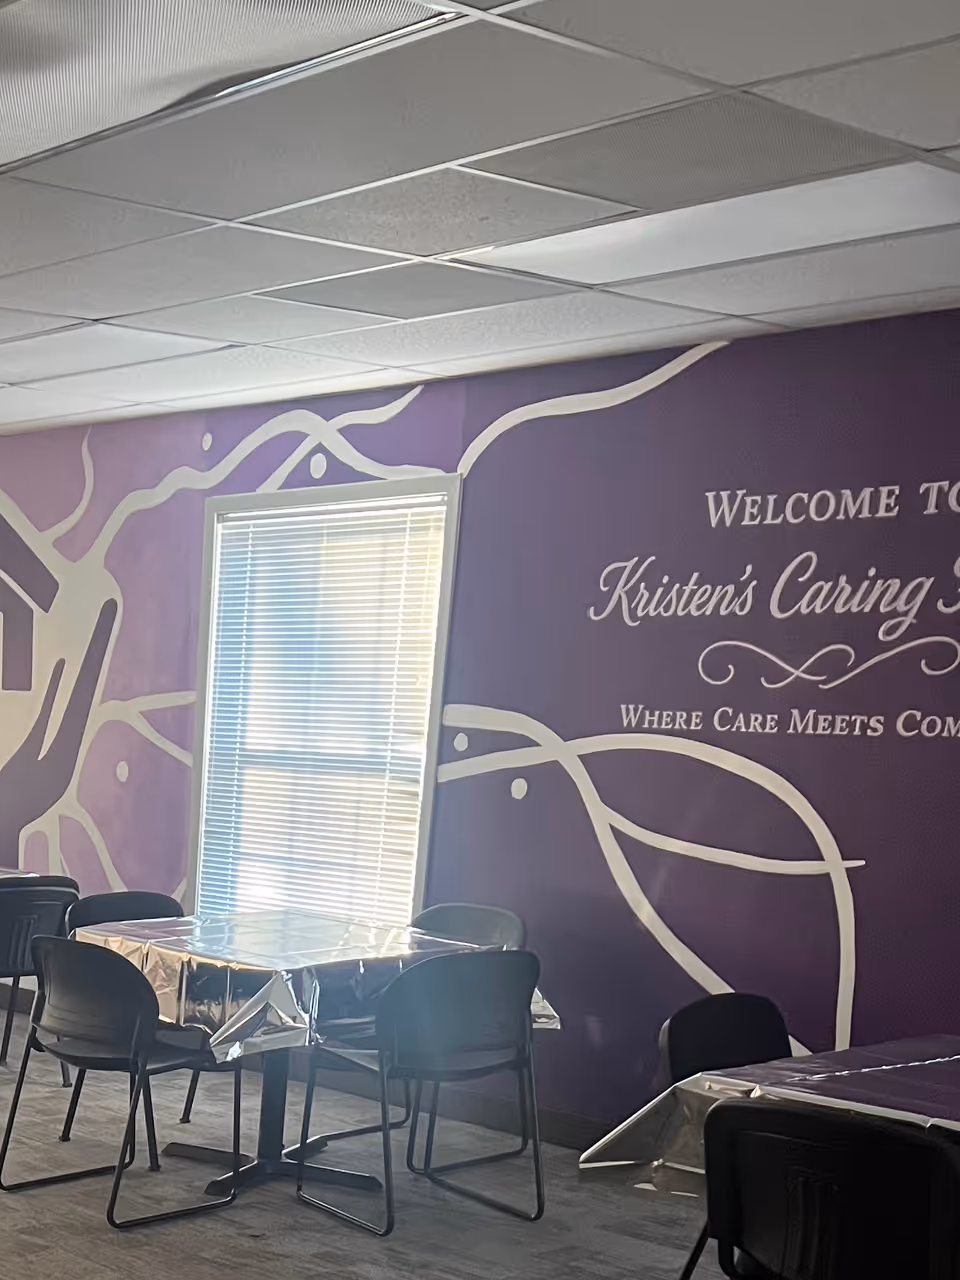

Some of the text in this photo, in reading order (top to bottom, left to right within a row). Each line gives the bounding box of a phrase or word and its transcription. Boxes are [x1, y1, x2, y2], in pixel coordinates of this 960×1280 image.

[705, 485, 900, 528] WELCOME
[588, 555, 758, 627] Kristen's
[769, 551, 935, 642] Caring
[620, 704, 703, 730] WHERE
[713, 706, 779, 733] CARE
[786, 708, 885, 737] MEETS
